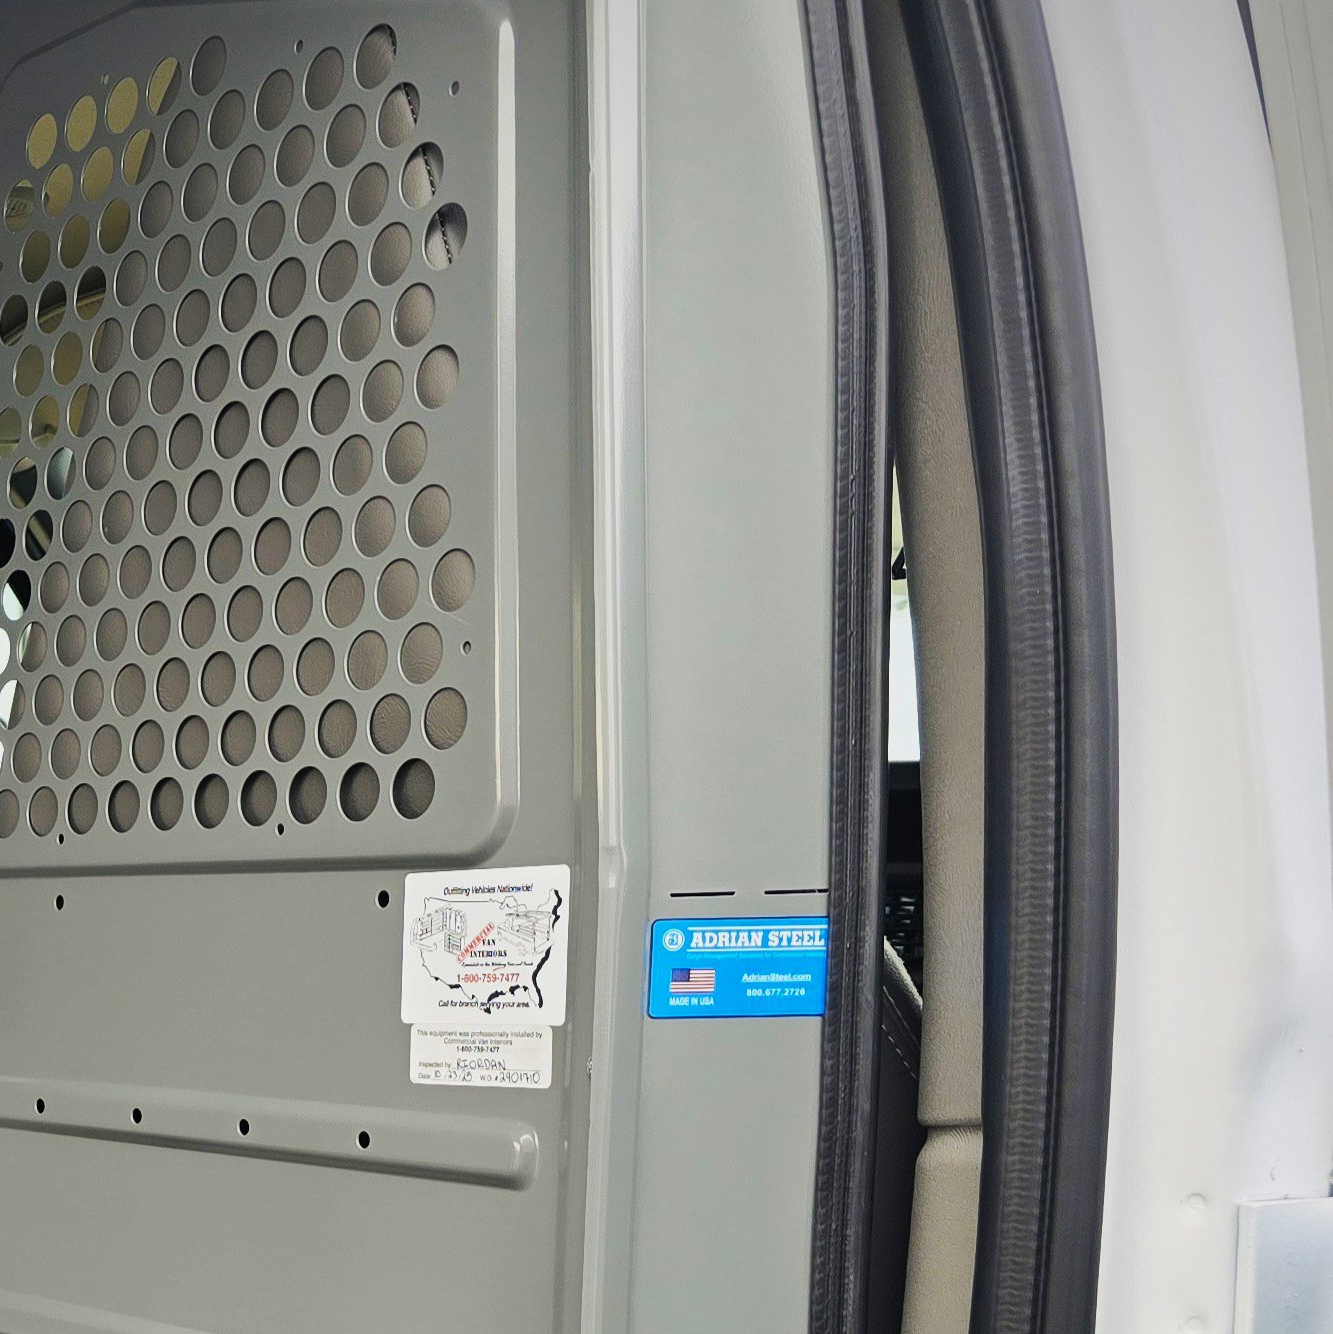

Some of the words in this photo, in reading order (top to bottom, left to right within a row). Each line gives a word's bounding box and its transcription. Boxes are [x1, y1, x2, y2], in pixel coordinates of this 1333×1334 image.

[457, 921, 495, 963] COMMERCIAL
[482, 938, 497, 946] VAN
[690, 931, 763, 948] ADRIAN
[768, 930, 826, 947] STEEL
[470, 950, 508, 958] INTERIORS
[457, 973, 520, 983] 1-800-759-7477
[741, 972, 812, 982] AdrianSteel.com
[669, 996, 690, 1006] MADE
[691, 996, 699, 1006] IN
[699, 996, 714, 1006] USA
[471, 1030, 509, 1038] professionally
[536, 1031, 543, 1039] by
[419, 1060, 444, 1068] Inspected
